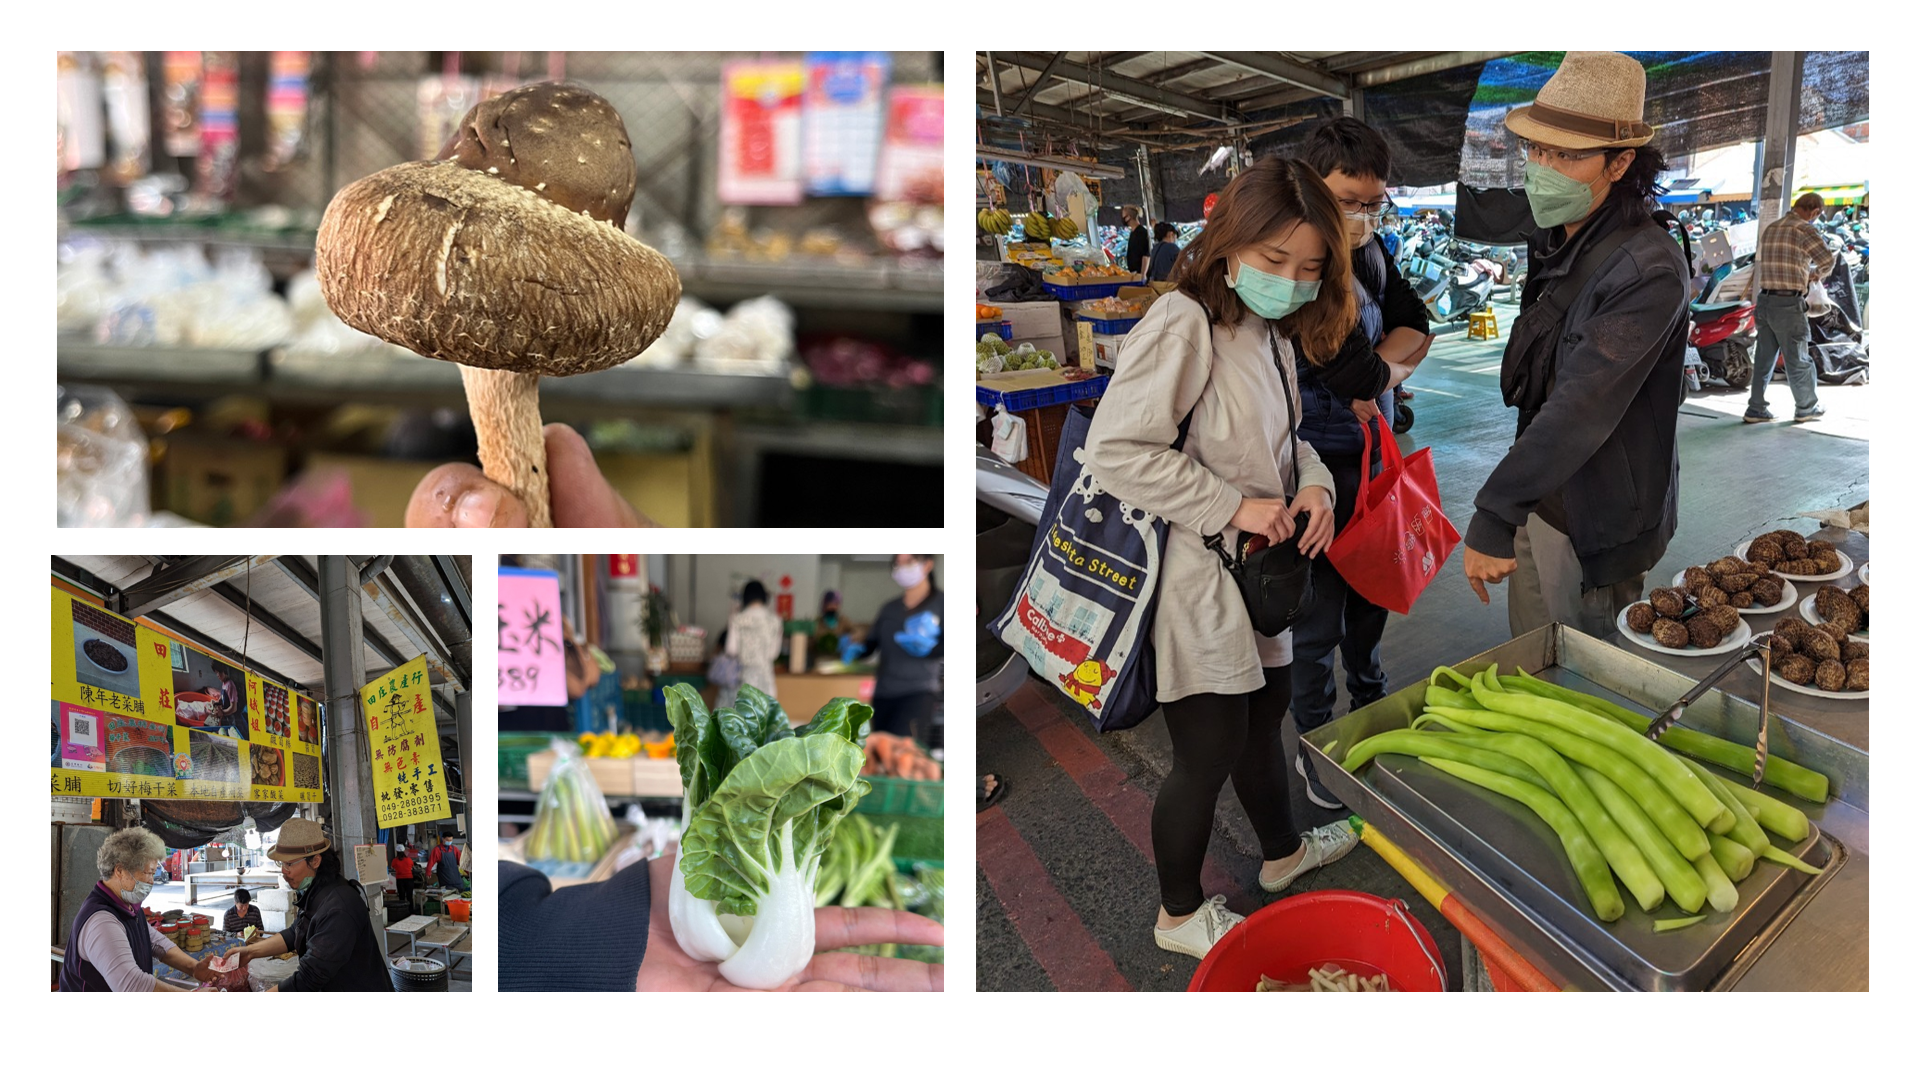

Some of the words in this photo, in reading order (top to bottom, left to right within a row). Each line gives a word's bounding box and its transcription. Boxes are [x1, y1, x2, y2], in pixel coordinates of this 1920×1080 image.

[1088, 558, 1138, 591] Street
[80, 685, 145, 714] 陳年老菜脯
[381, 792, 442, 813] 049-2880395
[382, 802, 443, 822] 0928-383871
